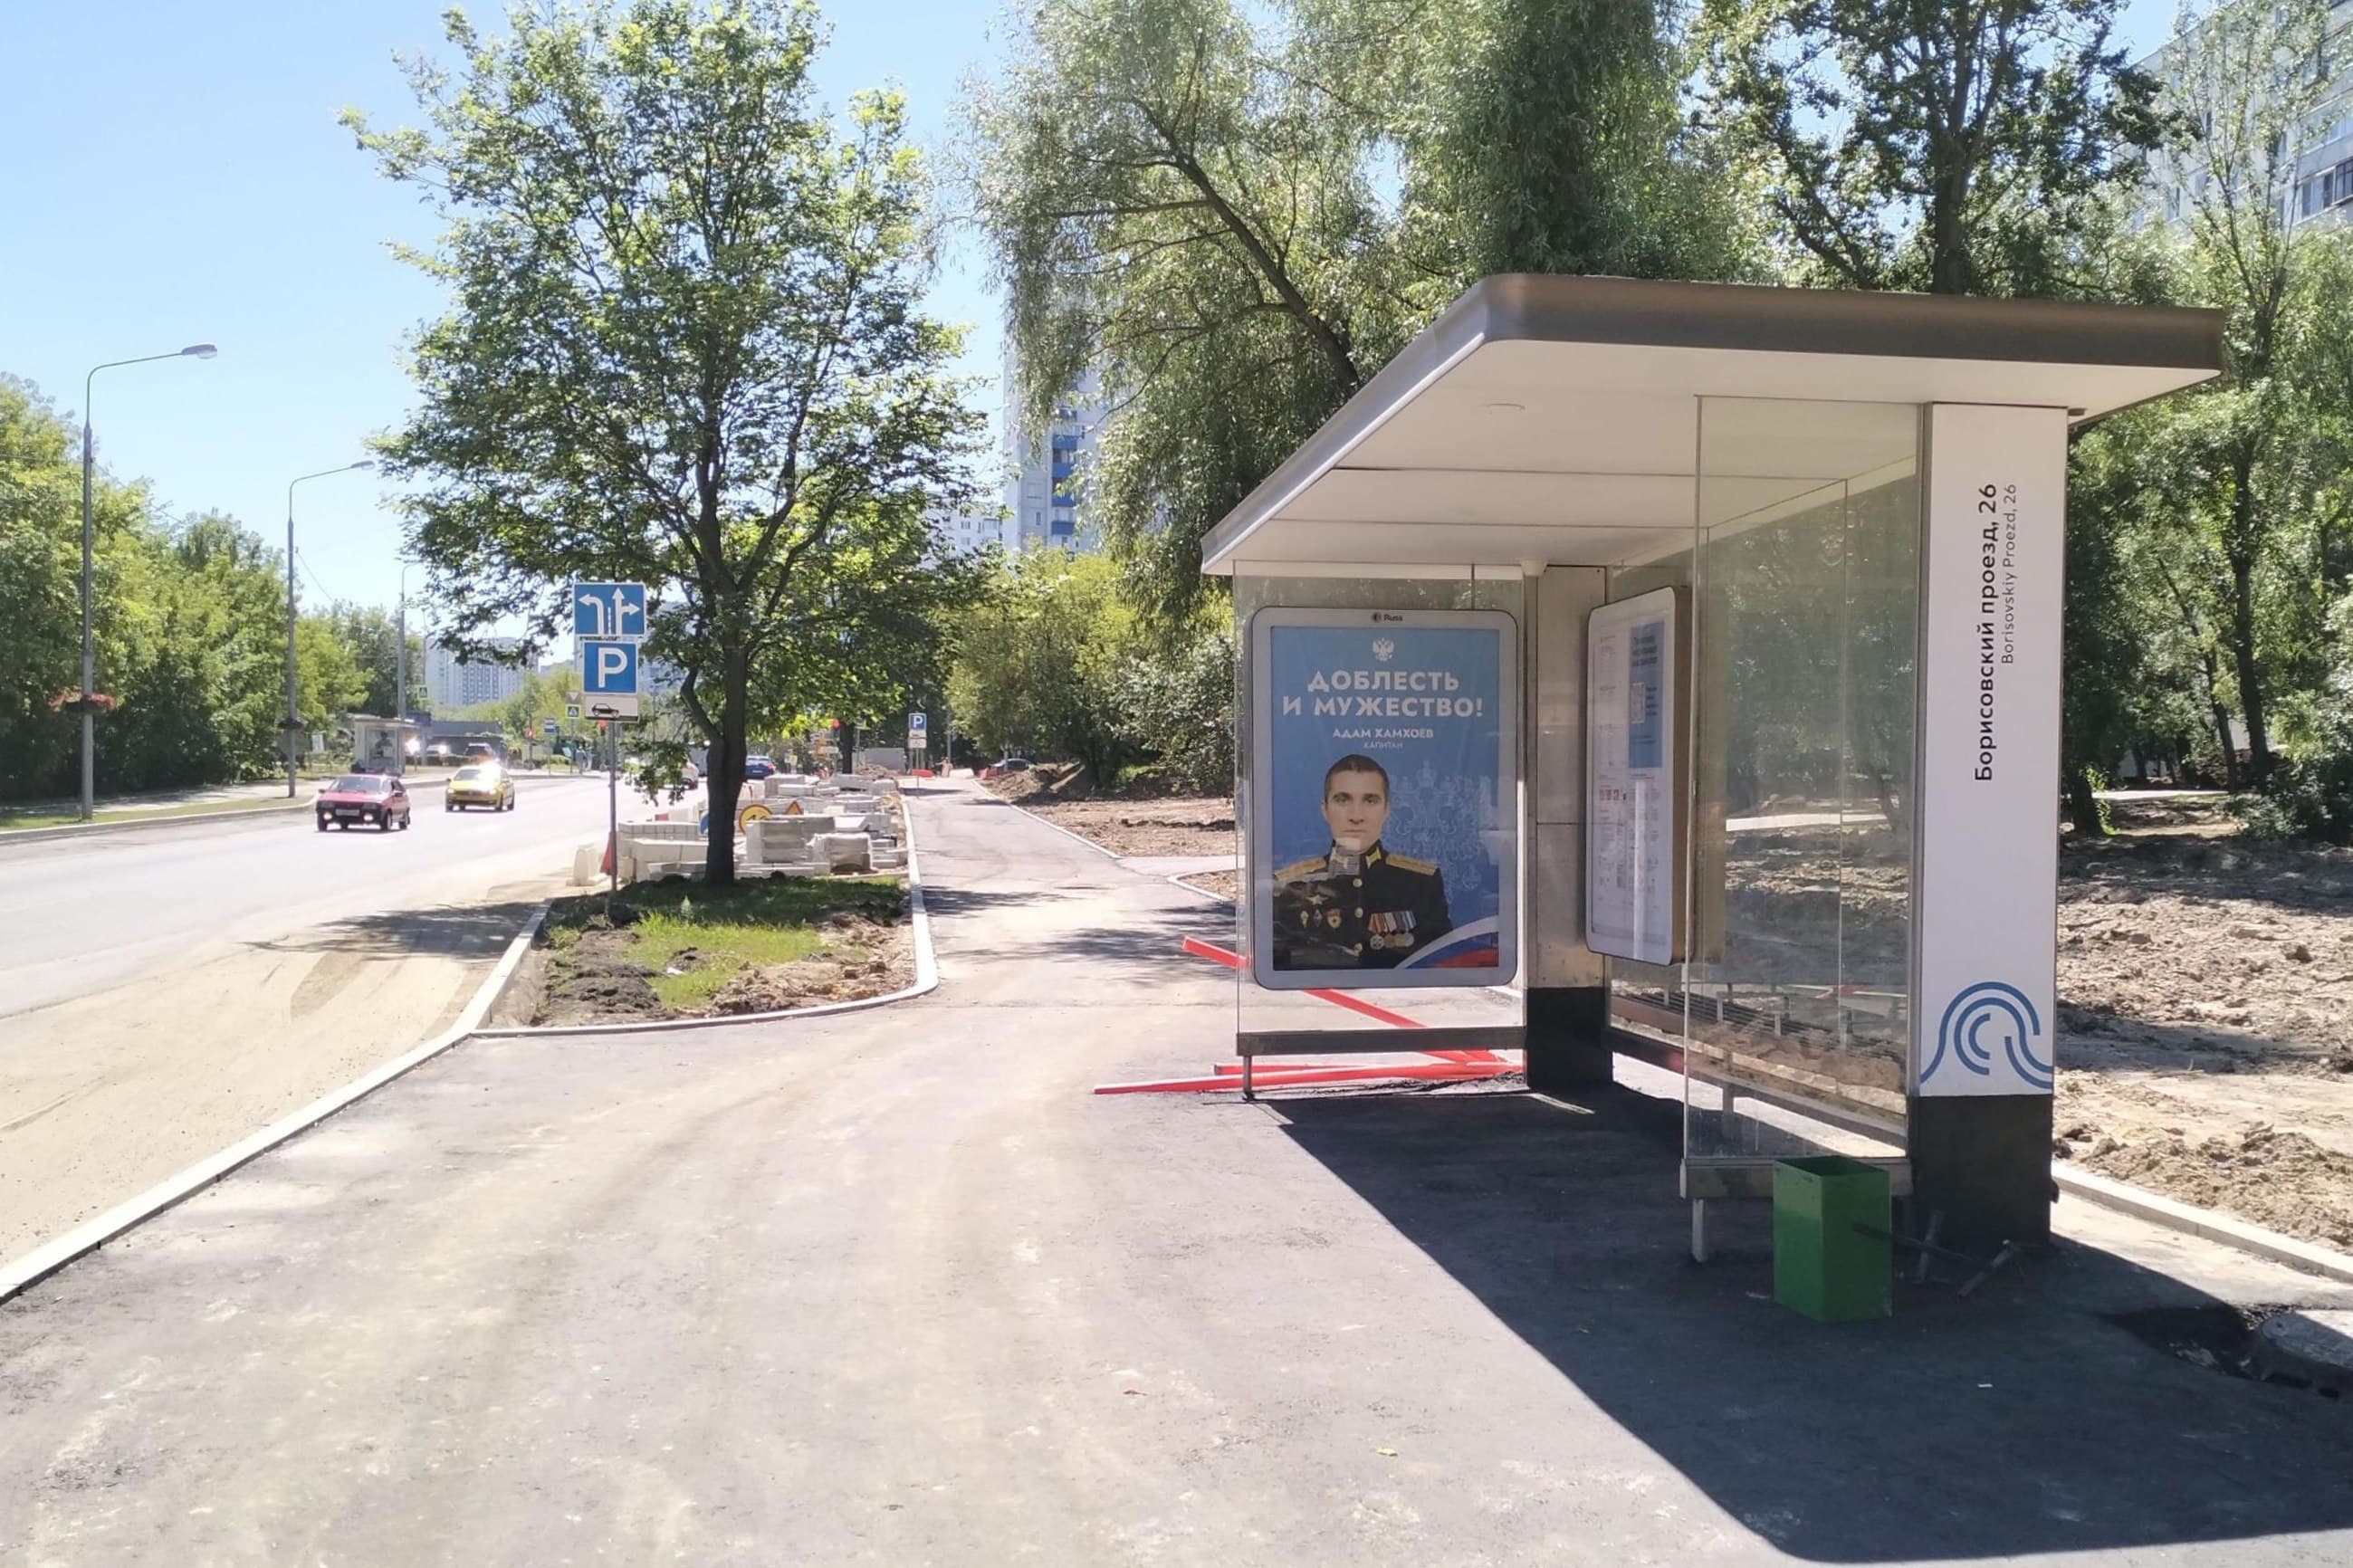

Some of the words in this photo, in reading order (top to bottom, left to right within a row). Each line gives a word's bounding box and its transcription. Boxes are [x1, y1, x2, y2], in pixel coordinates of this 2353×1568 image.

[1977, 483, 1997, 514] 26
[2003, 483, 2017, 504] 26
[2002, 508, 2018, 569] Proezd,
[1981, 521, 2000, 614] проезд,
[2001, 572, 2019, 664] Borisovskiy
[598, 646, 628, 688] P
[1306, 670, 1460, 693] ДОБЛЕСТЬ
[1282, 695, 1302, 717] И
[1314, 696, 1484, 718] МУЖЕСТВО!
[1975, 622, 1998, 781] Борисовский
[913, 715, 923, 729] P
[1332, 728, 1372, 740] АДАМ
[1374, 728, 1435, 740] ХАМХОЕВ
